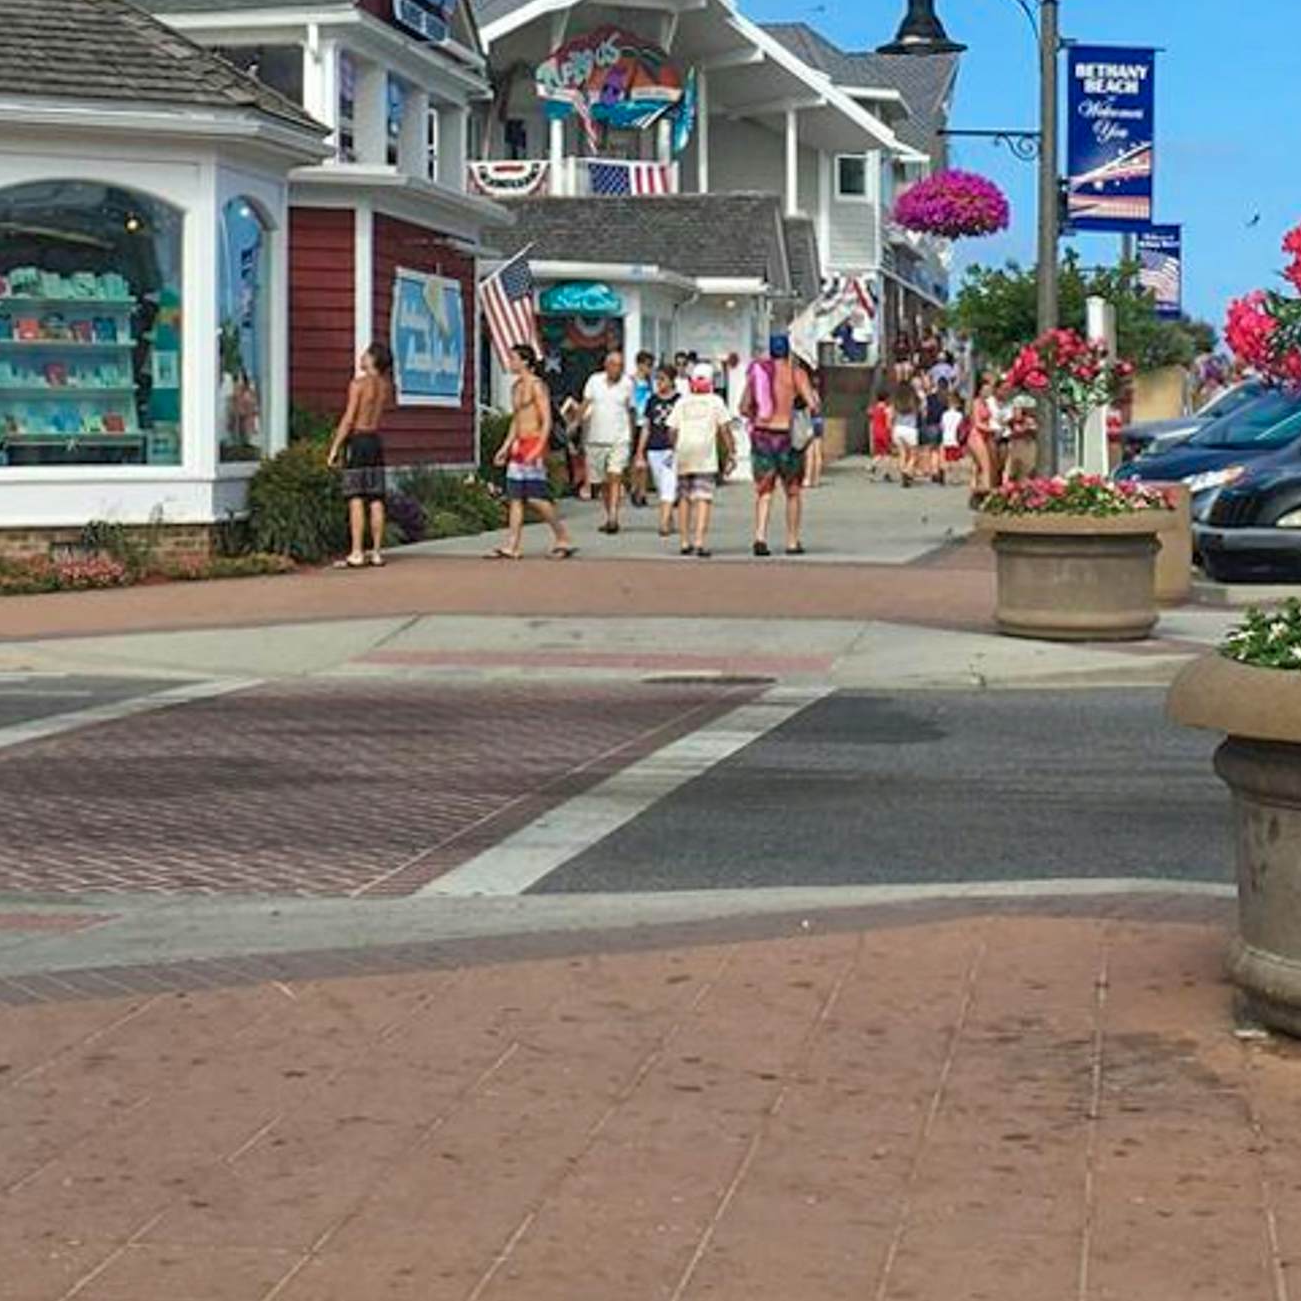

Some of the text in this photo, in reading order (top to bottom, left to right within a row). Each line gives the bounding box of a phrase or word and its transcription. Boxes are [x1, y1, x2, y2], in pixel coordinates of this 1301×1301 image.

[1075, 63, 1149, 80] BETHANY
[1083, 79, 1139, 93] BEACH
[1092, 120, 1129, 143] You
